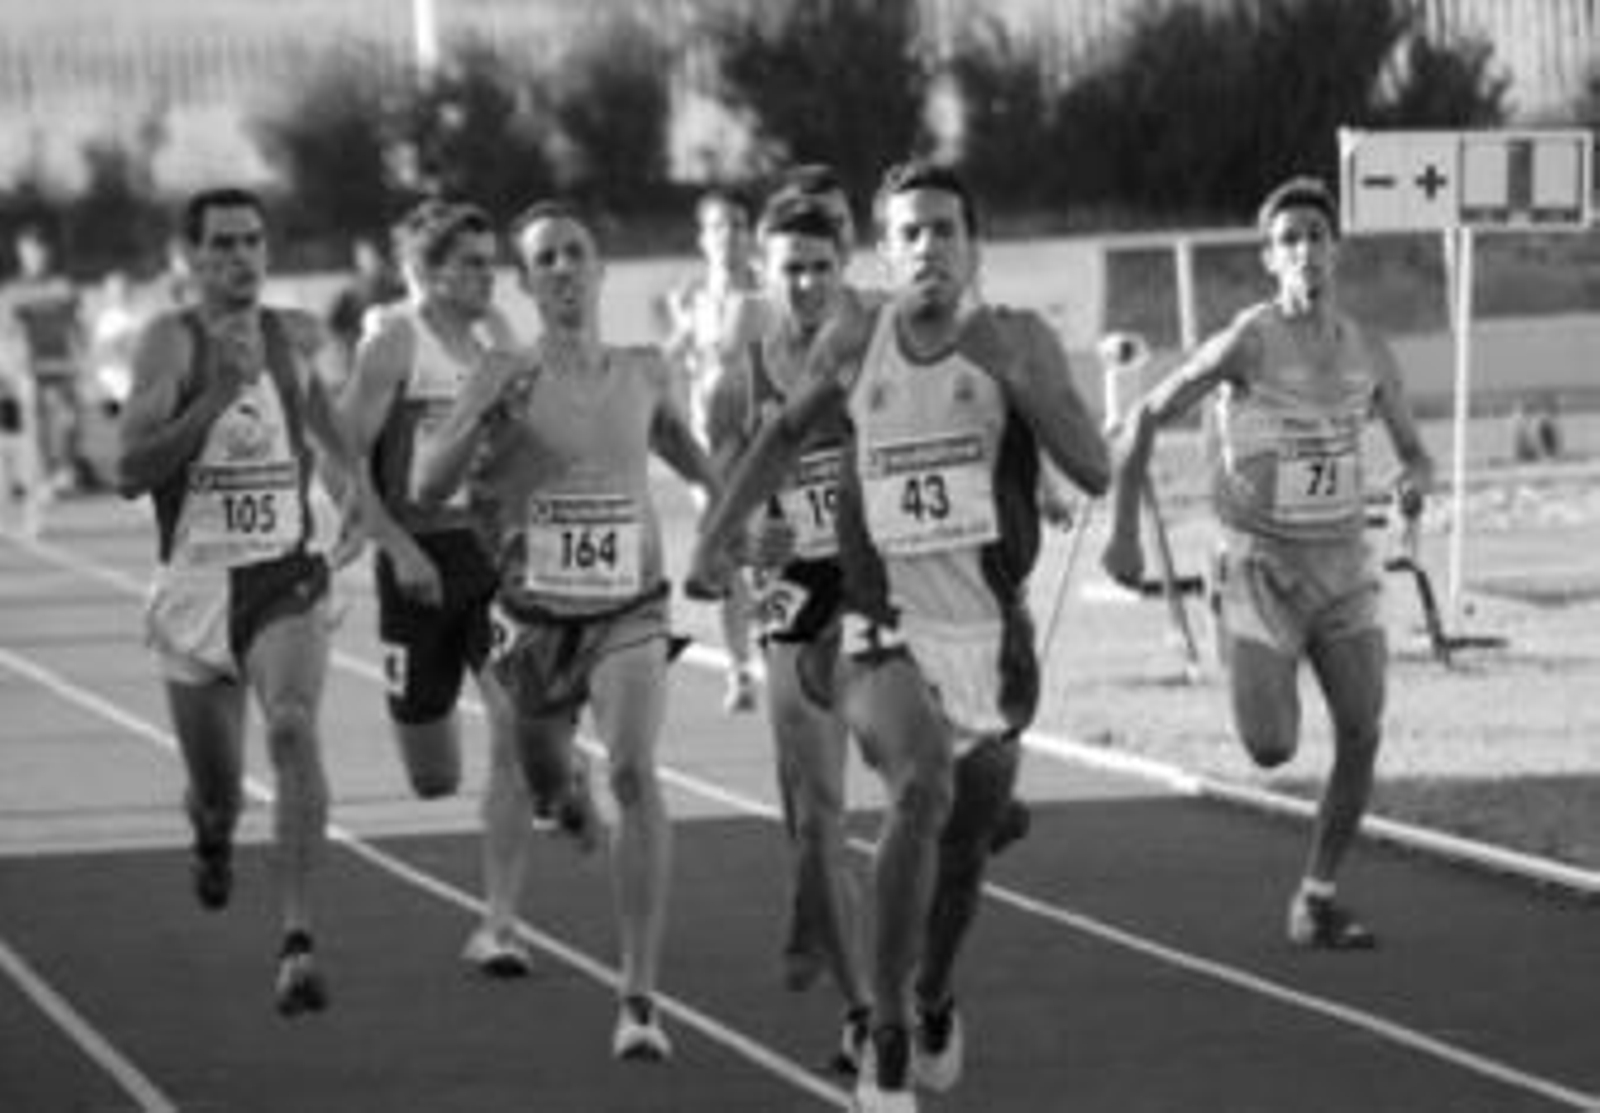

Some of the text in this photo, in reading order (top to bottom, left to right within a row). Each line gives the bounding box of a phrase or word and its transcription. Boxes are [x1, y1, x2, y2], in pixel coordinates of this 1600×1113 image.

[222, 494, 276, 534] 105
[901, 474, 950, 520] 43
[560, 530, 617, 571] 164
